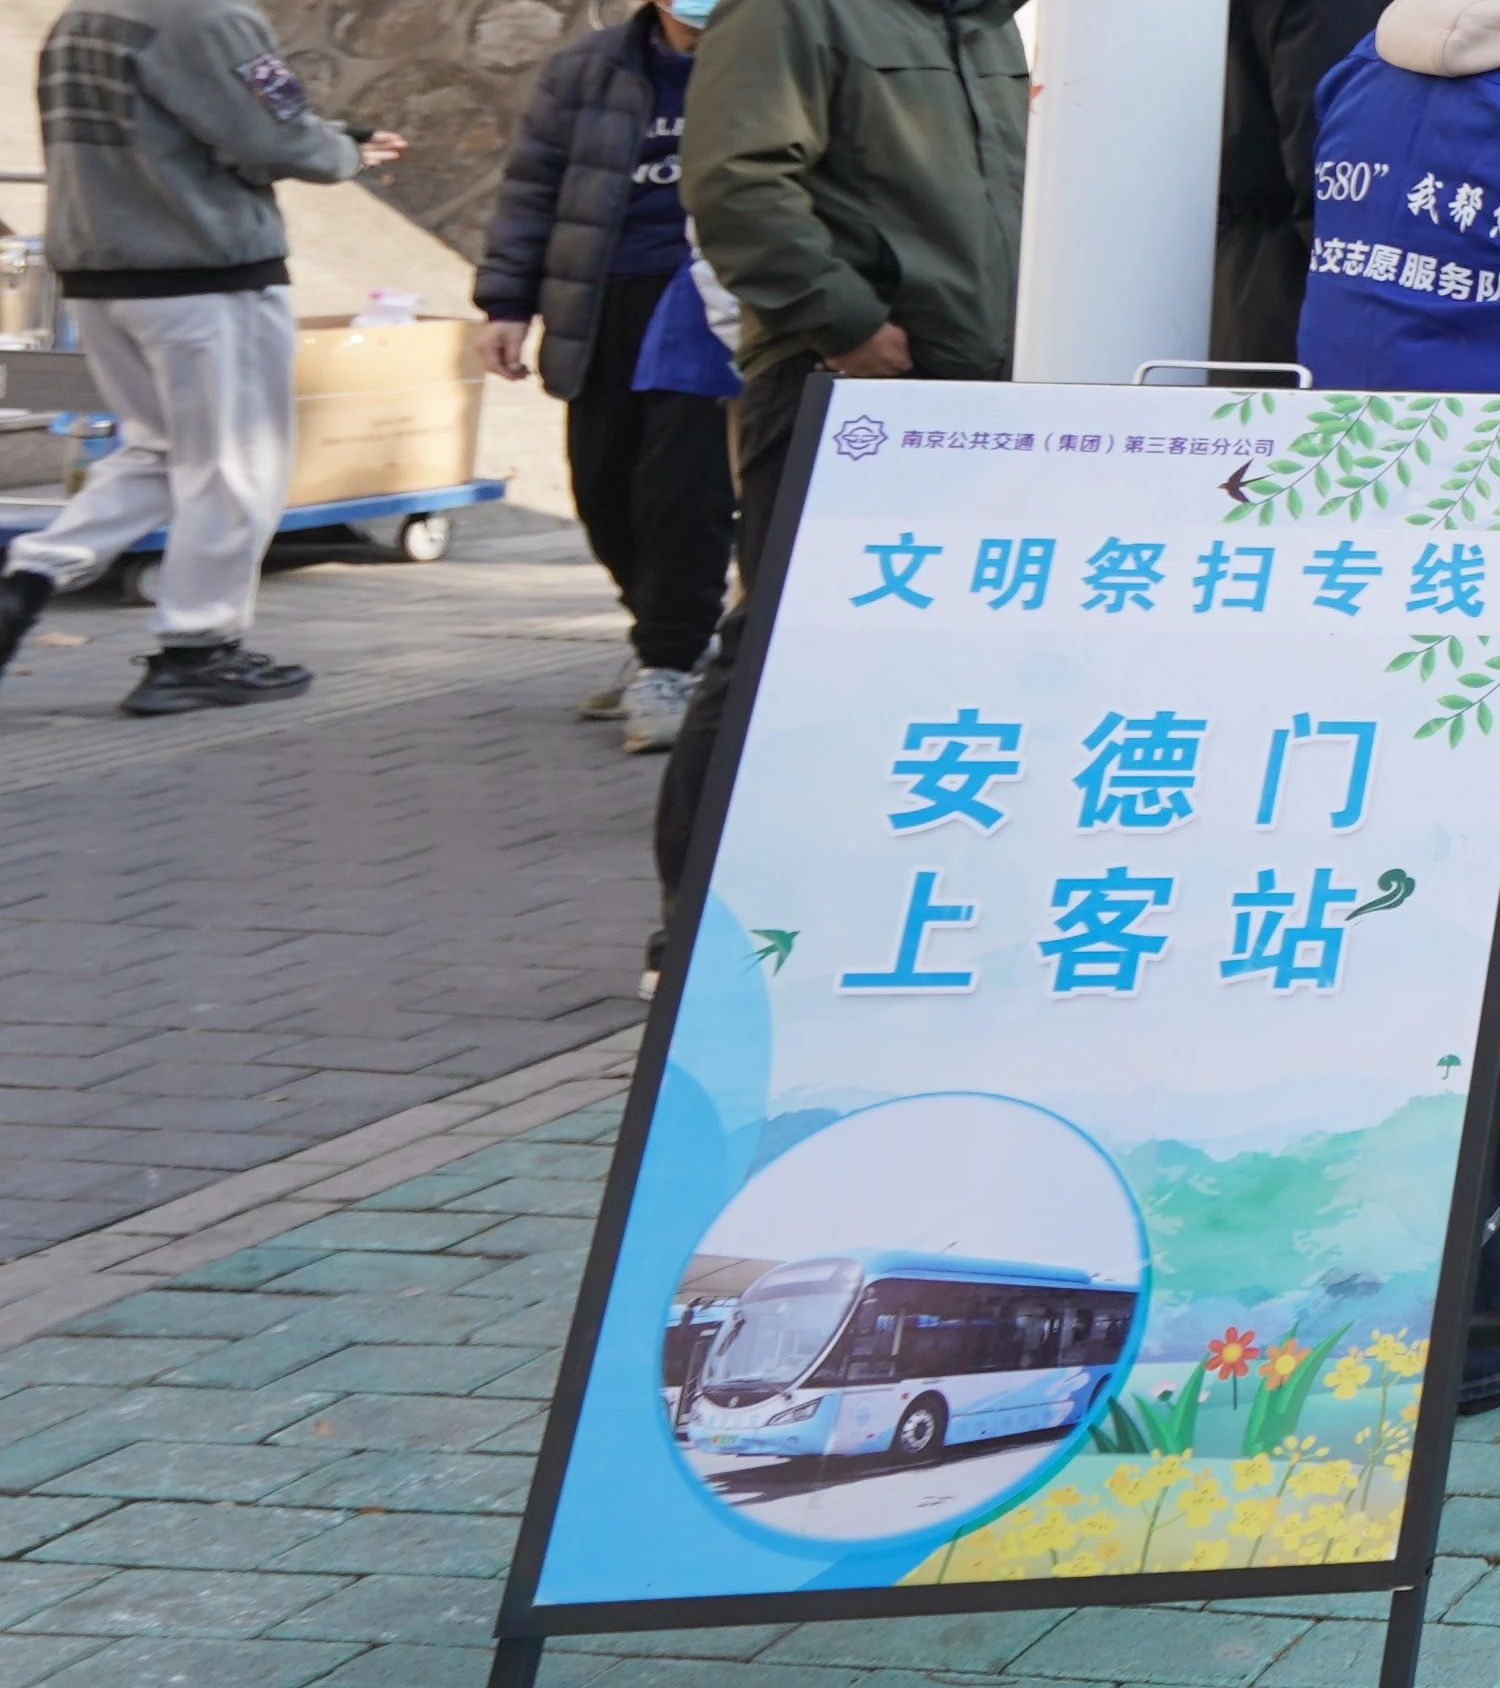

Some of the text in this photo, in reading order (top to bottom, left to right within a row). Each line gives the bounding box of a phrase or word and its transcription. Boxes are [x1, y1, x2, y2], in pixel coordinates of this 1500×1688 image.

[900, 429, 1275, 457] 南京公共交通（集团）第三客运分公司
[850, 531, 1488, 619] 文明祭扫专线
[886, 707, 1380, 833] 安德门
[839, 867, 1358, 993] 上客站
